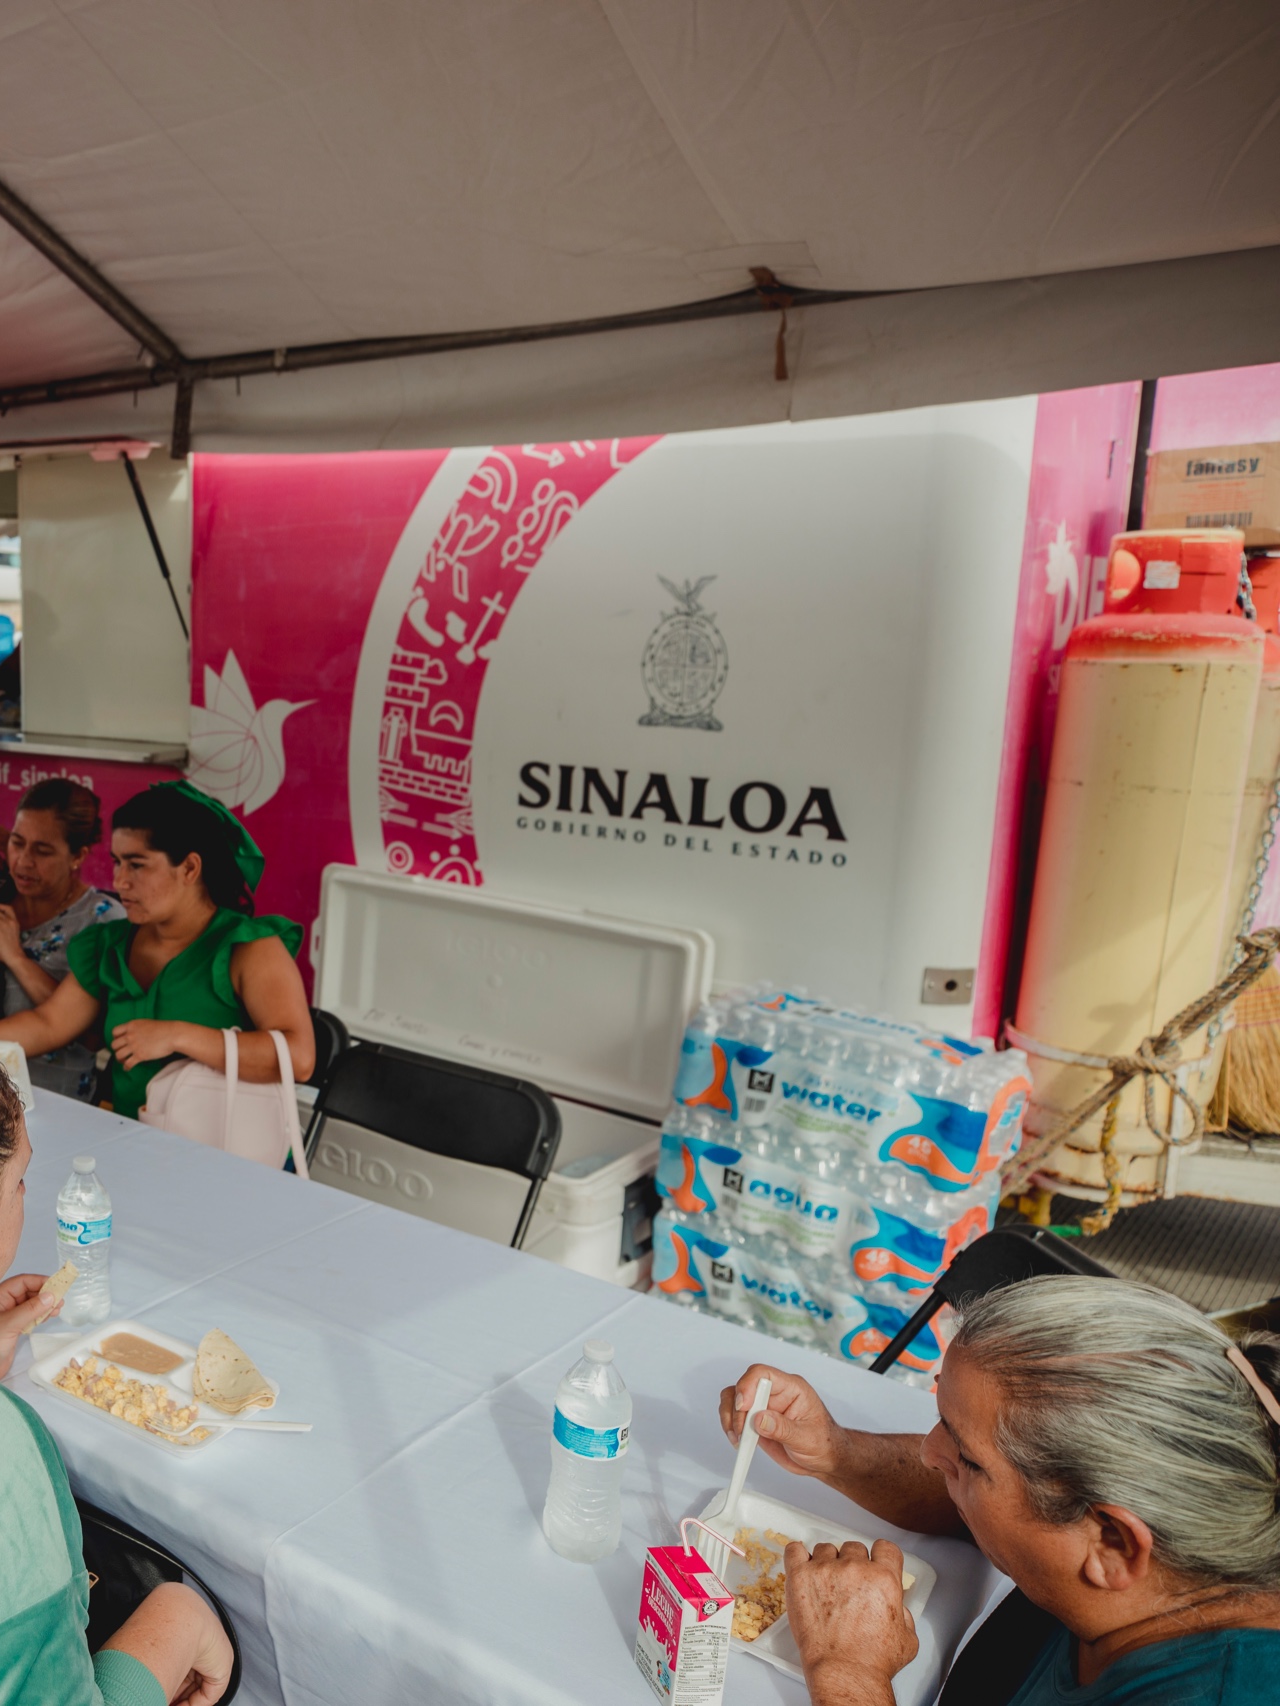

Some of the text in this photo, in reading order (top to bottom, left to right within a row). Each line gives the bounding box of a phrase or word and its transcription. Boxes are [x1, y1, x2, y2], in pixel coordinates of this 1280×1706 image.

[517, 761, 849, 843] SINALOA
[516, 816, 849, 868] GOBIERNO DEL ESTADO
[781, 1081, 882, 1124] water
[318, 1142, 434, 1203] GLOO
[865, 1249, 890, 1265] 45
[650, 1580, 674, 1624] LECHE
